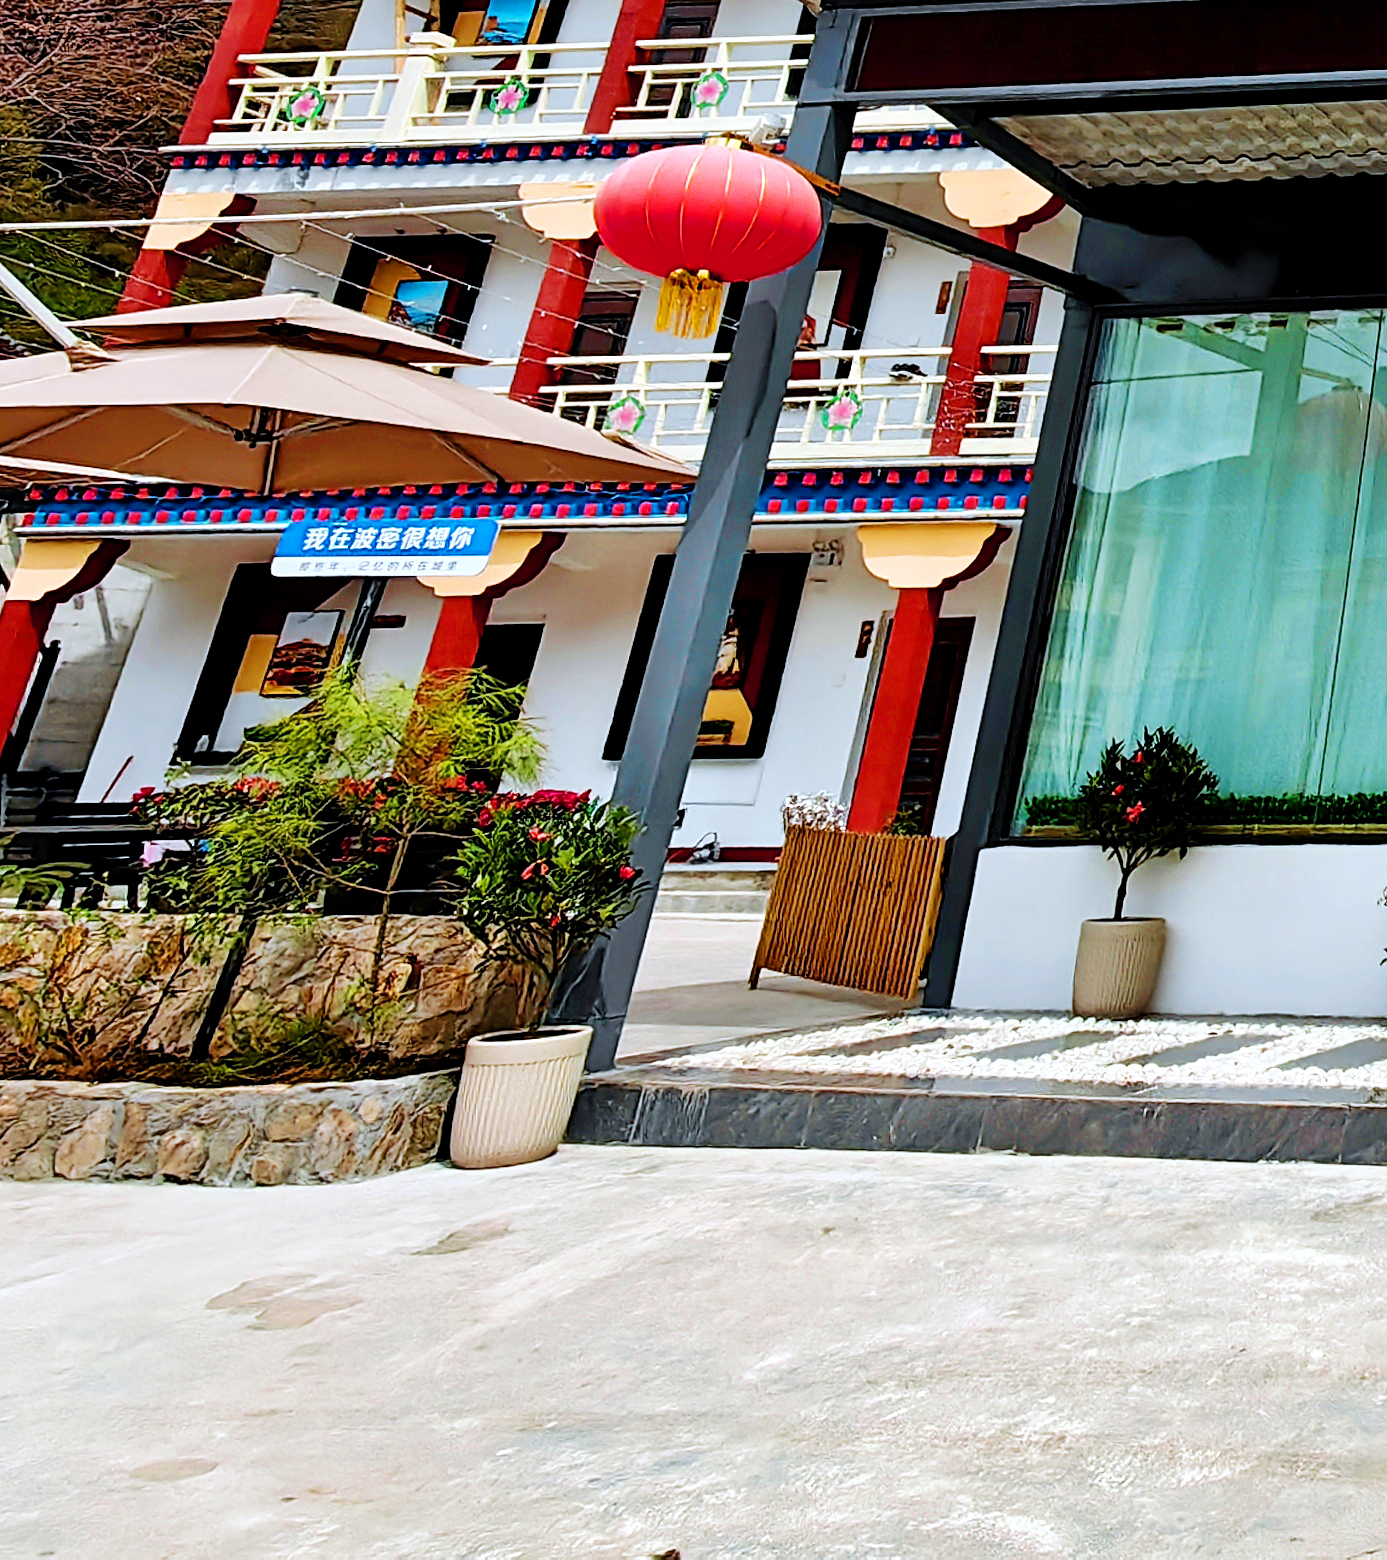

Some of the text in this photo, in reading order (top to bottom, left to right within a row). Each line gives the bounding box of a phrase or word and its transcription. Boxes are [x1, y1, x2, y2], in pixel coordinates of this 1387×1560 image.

[302, 526, 475, 551] 我在波密很想你
